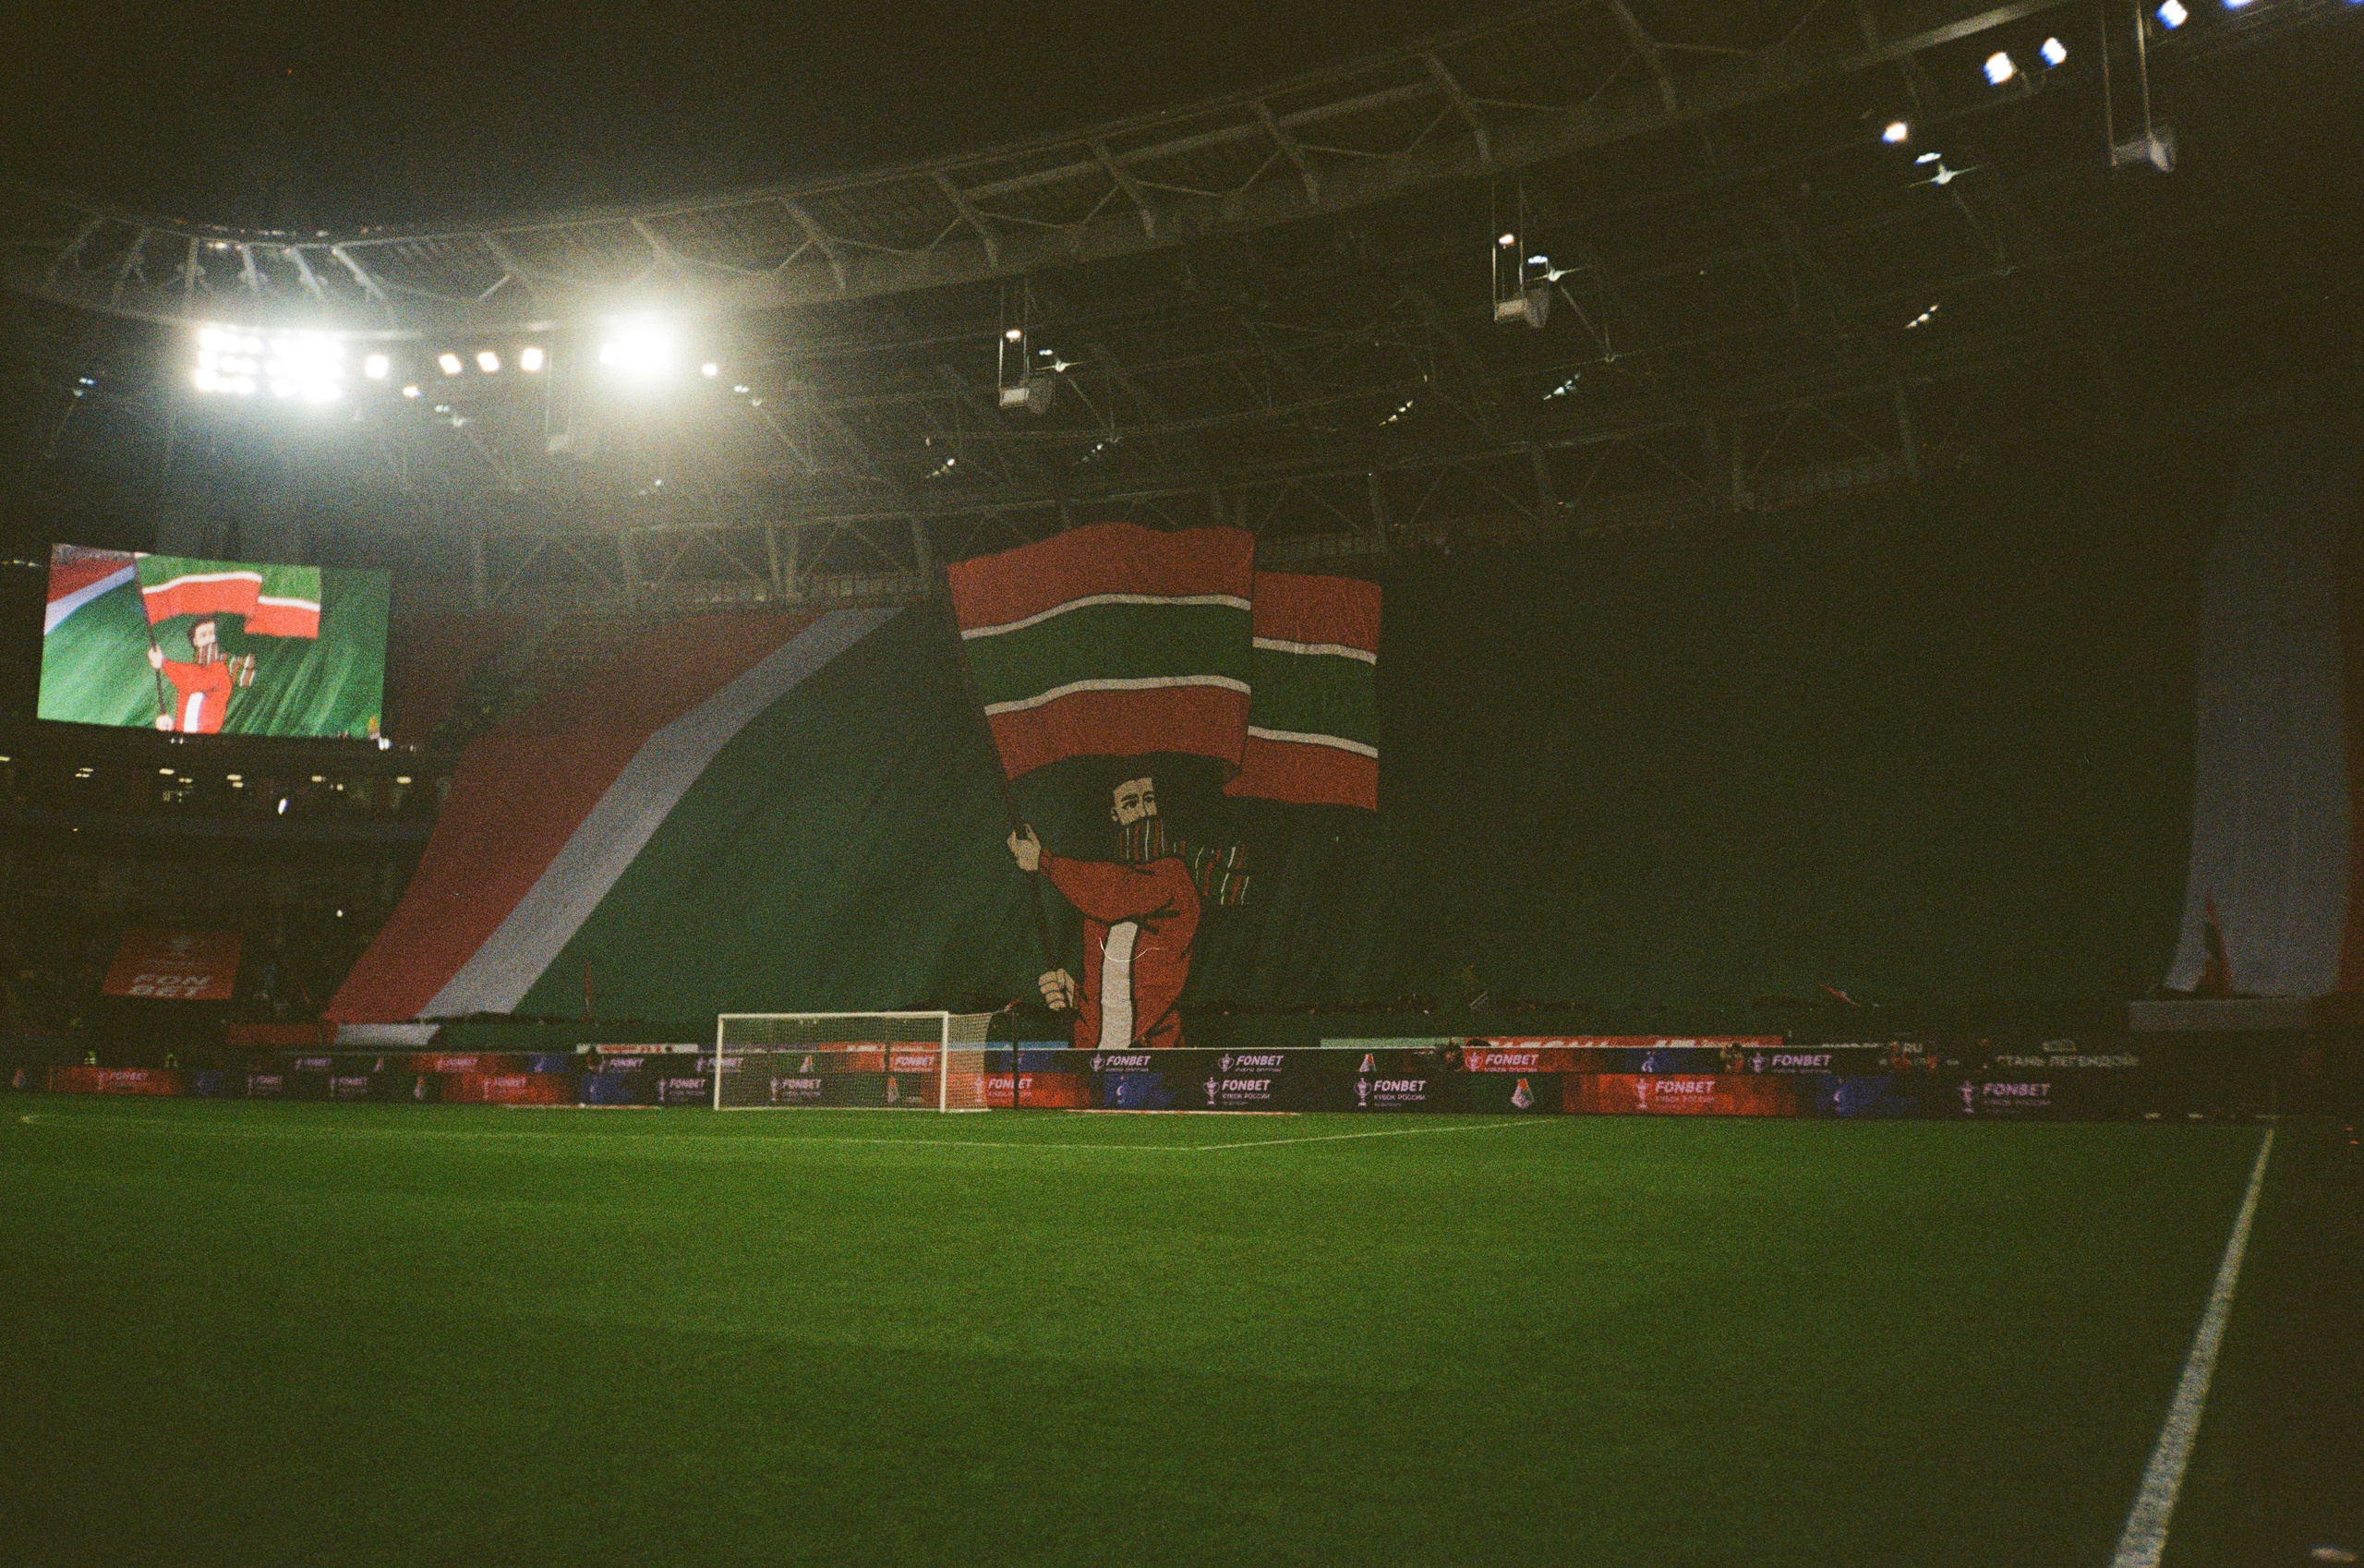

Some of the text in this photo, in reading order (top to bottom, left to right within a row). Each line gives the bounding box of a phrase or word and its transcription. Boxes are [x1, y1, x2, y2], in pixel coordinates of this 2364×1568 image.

[1105, 1055, 1152, 1066] FONBET
[1236, 1055, 1285, 1066] FONBET
[1485, 1054, 1539, 1066] FONBET
[1771, 1055, 1832, 1067] FONBET
[987, 1079, 1032, 1090] FONET
[1221, 1080, 1272, 1091] FONBET
[1373, 1080, 1427, 1092] FONBET
[1655, 1081, 1715, 1093] FONBET
[1983, 1083, 2051, 1096] FONBET
